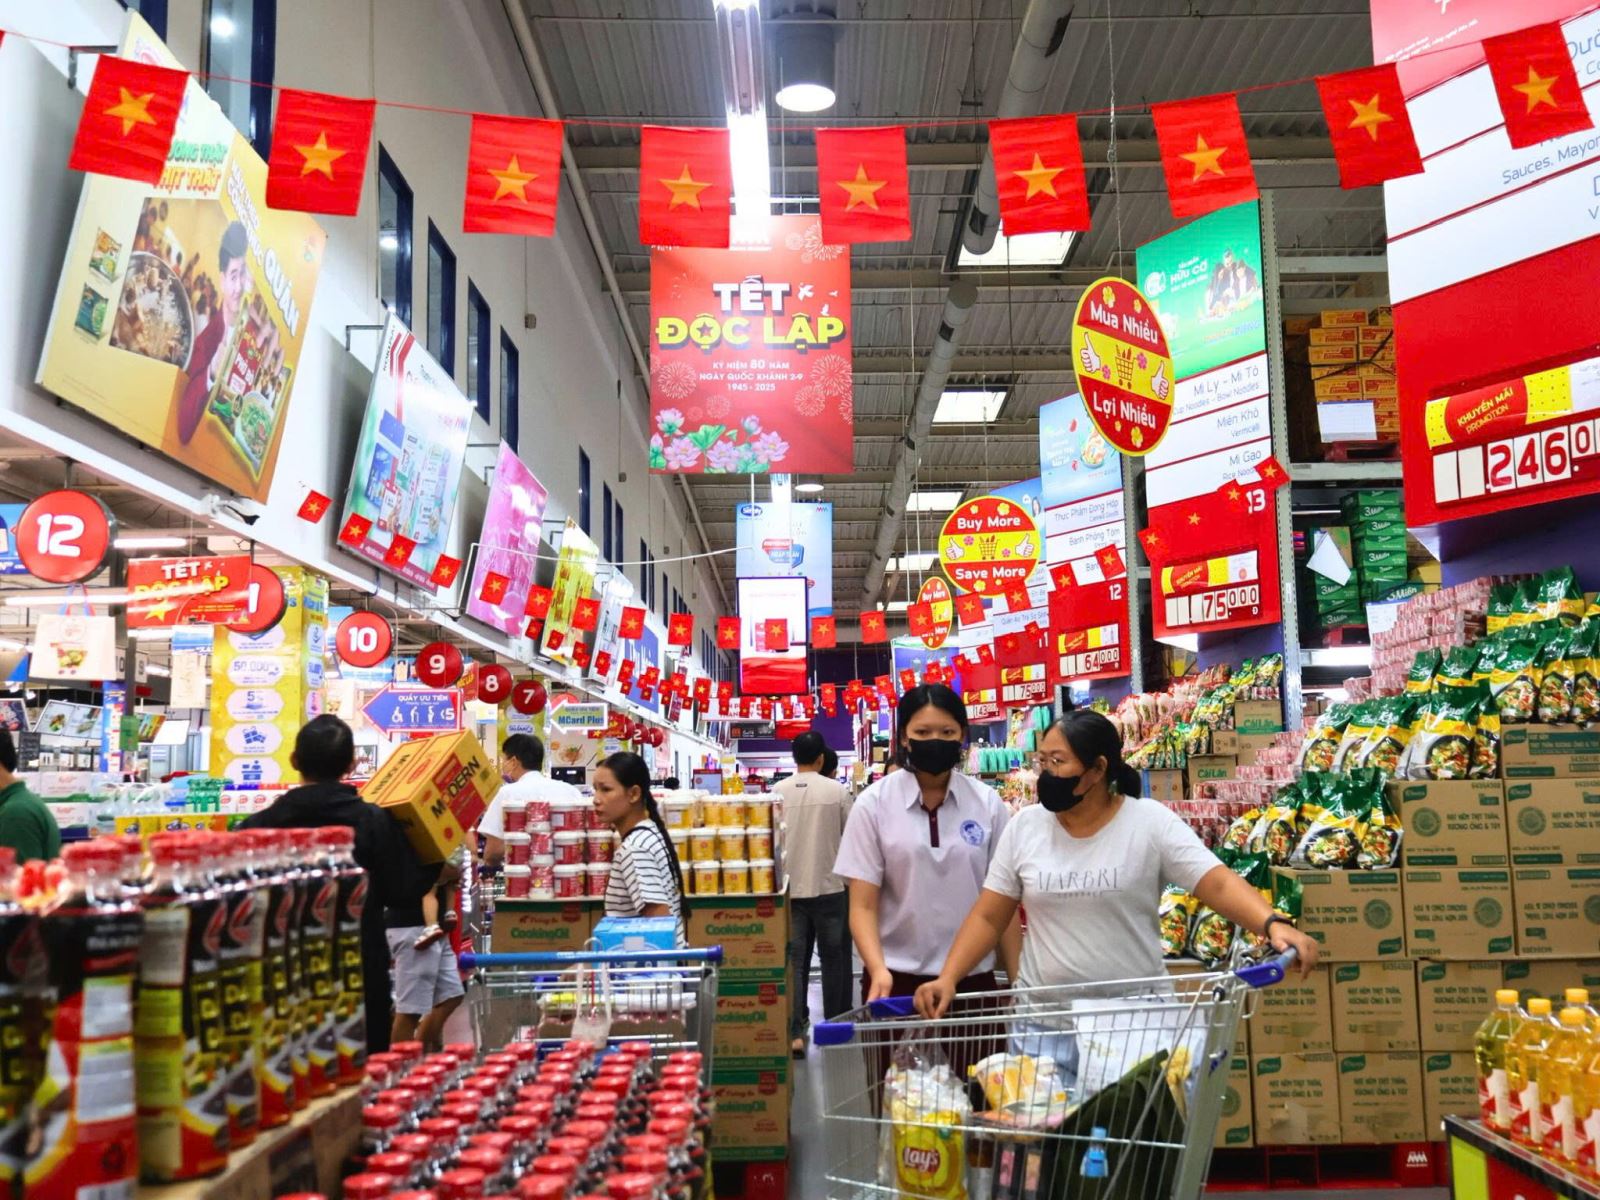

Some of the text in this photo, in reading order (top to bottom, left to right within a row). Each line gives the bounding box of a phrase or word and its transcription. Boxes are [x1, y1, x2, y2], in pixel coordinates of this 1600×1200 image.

[712, 275, 790, 311] TẾT
[656, 312, 844, 350] ĐỘC LẬP
[1090, 301, 1158, 344] Mua Nhiều
[750, 359, 766, 370] 80
[727, 370, 754, 381] QUỐC
[728, 383, 776, 391] 1945 2025
[1092, 391, 1156, 429] Lợi Nhiều
[1466, 403, 1509, 435] PROMOTION
[1245, 488, 1266, 514] 13
[957, 516, 1020, 532] Buy More
[36, 513, 84, 557] 12
[161, 560, 201, 580] TẾT
[955, 568, 988, 580] Save
[992, 566, 1026, 578] More
[1109, 584, 1122, 600] 12
[348, 627, 377, 652] 10
[429, 655, 446, 675] 9
[485, 675, 499, 692] 8
[523, 689, 535, 704] 7
[558, 716, 604, 725] MCard Plus
[633, 729, 642, 740] 2
[705, 922, 765, 936] CookingOil
[716, 1011, 767, 1023] ookingOil
[903, 1146, 940, 1172] Lay's
